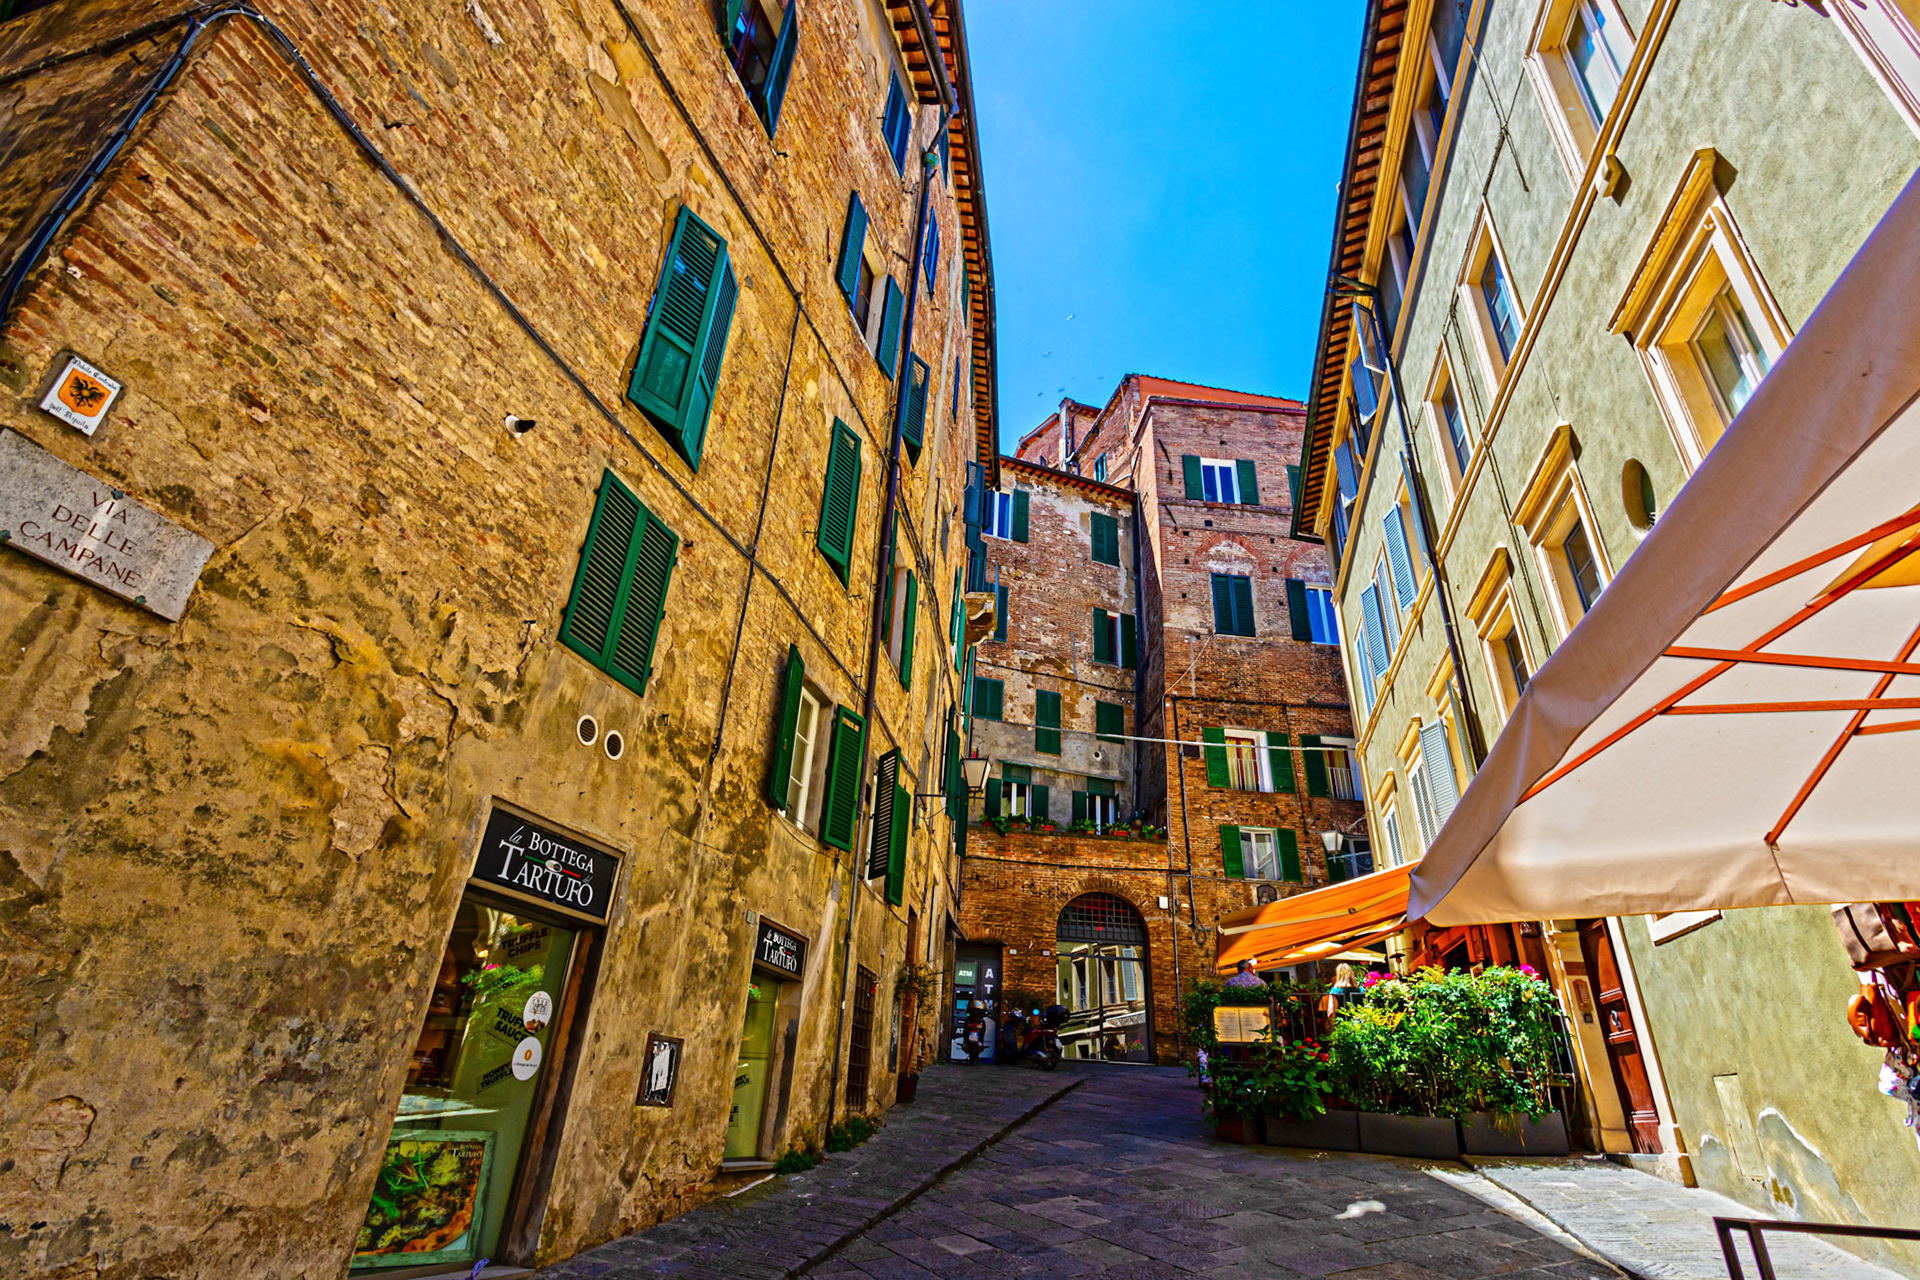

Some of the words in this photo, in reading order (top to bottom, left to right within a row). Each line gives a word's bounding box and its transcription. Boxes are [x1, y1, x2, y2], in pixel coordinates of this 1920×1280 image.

[92, 491, 128, 524] VIA
[51, 504, 137, 556] DELLE
[19, 520, 141, 588] CAMPANE
[527, 832, 594, 874] BOTTEGA
[497, 839, 594, 907] TARTUFO
[500, 927, 548, 950] TRUFFLE
[508, 939, 541, 957] CHIPS
[763, 937, 797, 972] TARTUFO
[772, 932, 797, 952] BOTTEGA
[958, 969, 973, 977] ATM
